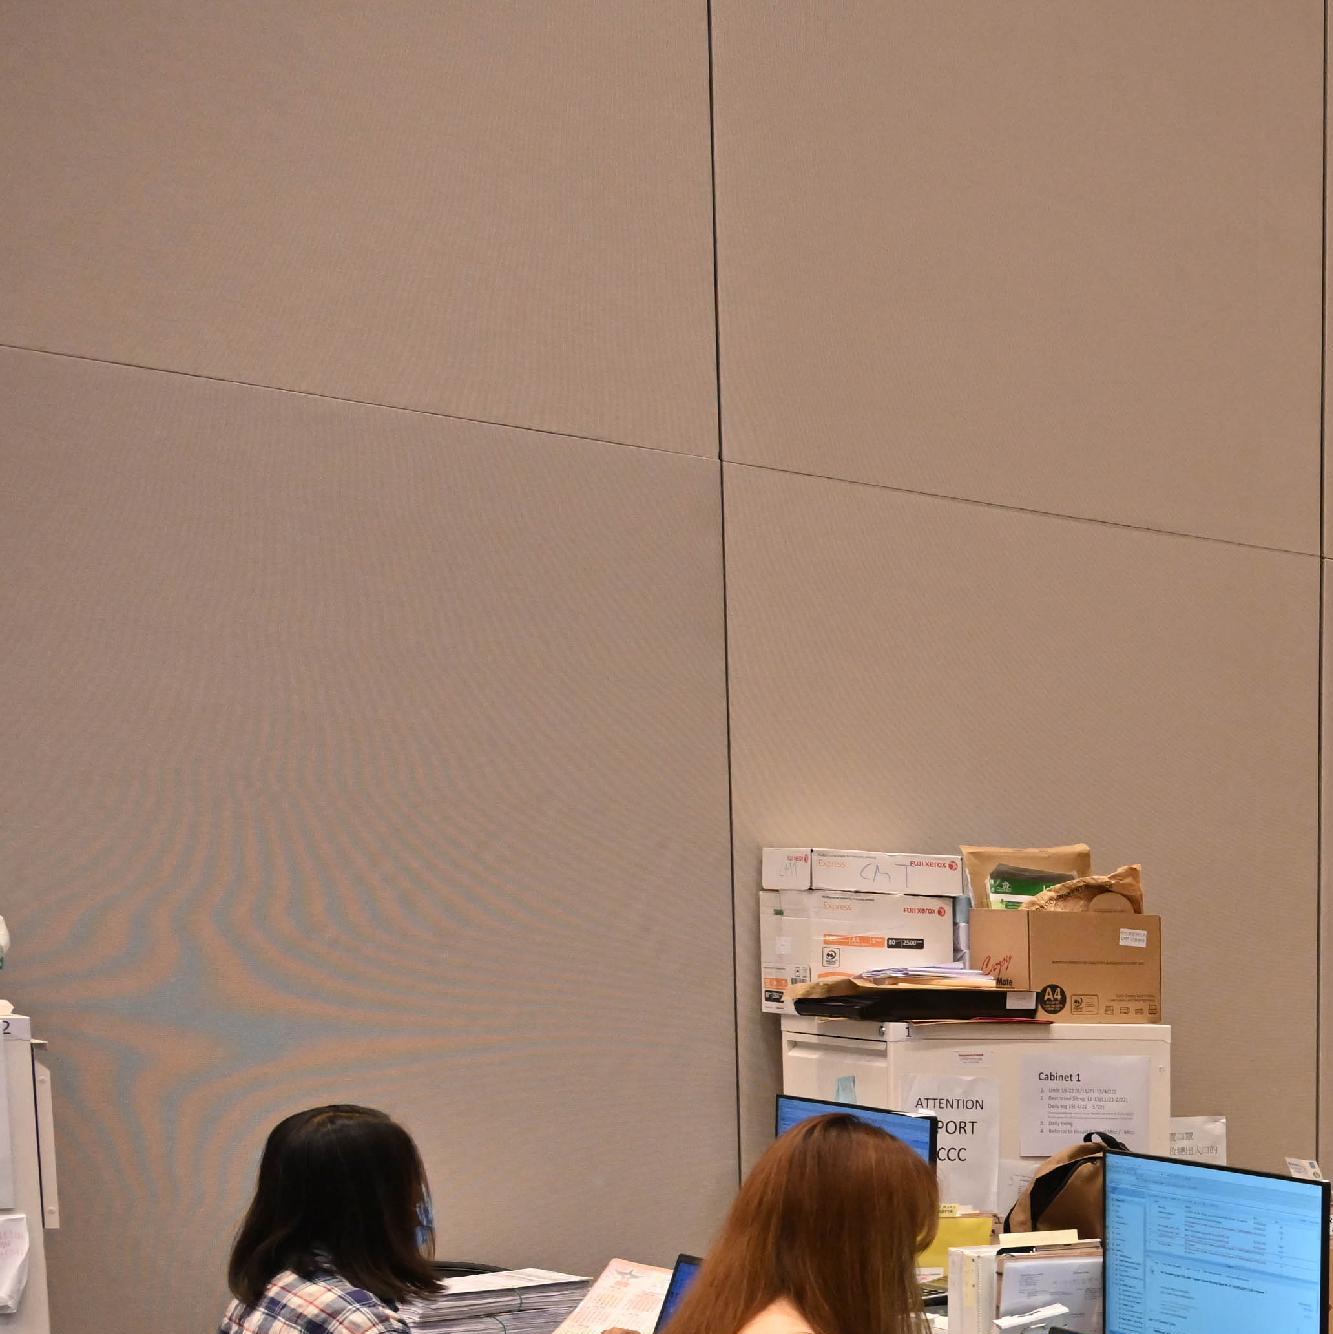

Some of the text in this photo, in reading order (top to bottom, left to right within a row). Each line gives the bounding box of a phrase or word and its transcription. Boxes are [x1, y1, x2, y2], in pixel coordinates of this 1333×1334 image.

[1044, 986, 1061, 999] A4
[905, 1026, 912, 1038] 1
[1038, 1072, 1081, 1082] Cabinet 1
[915, 1097, 984, 1110] ATTENTION
[936, 1120, 978, 1135] PORT
